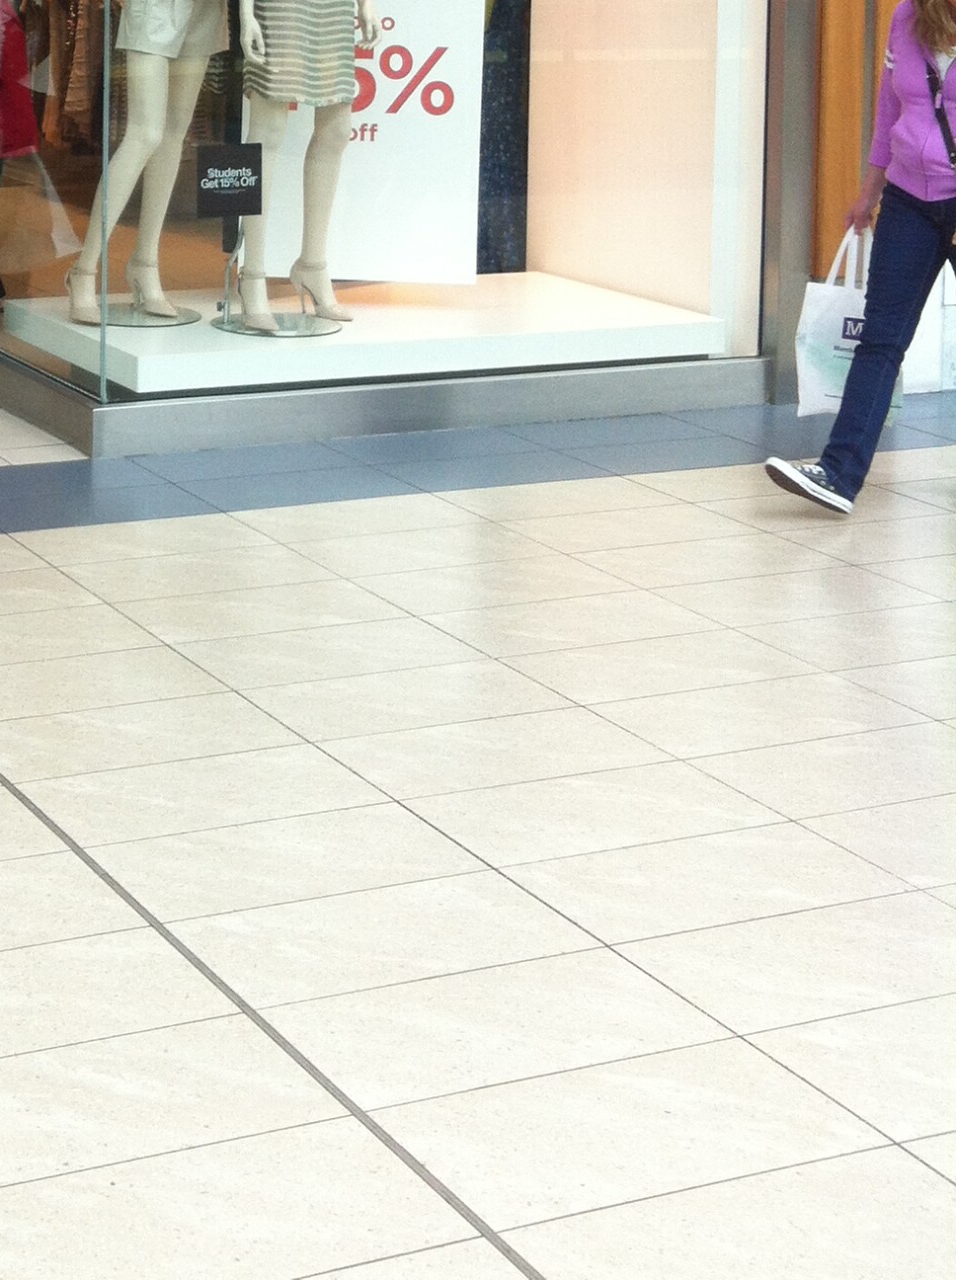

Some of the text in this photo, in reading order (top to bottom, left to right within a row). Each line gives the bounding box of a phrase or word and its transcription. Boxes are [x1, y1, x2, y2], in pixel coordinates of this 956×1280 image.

[207, 167, 252, 178] Students
[200, 175, 258, 189] Get 15% Off
